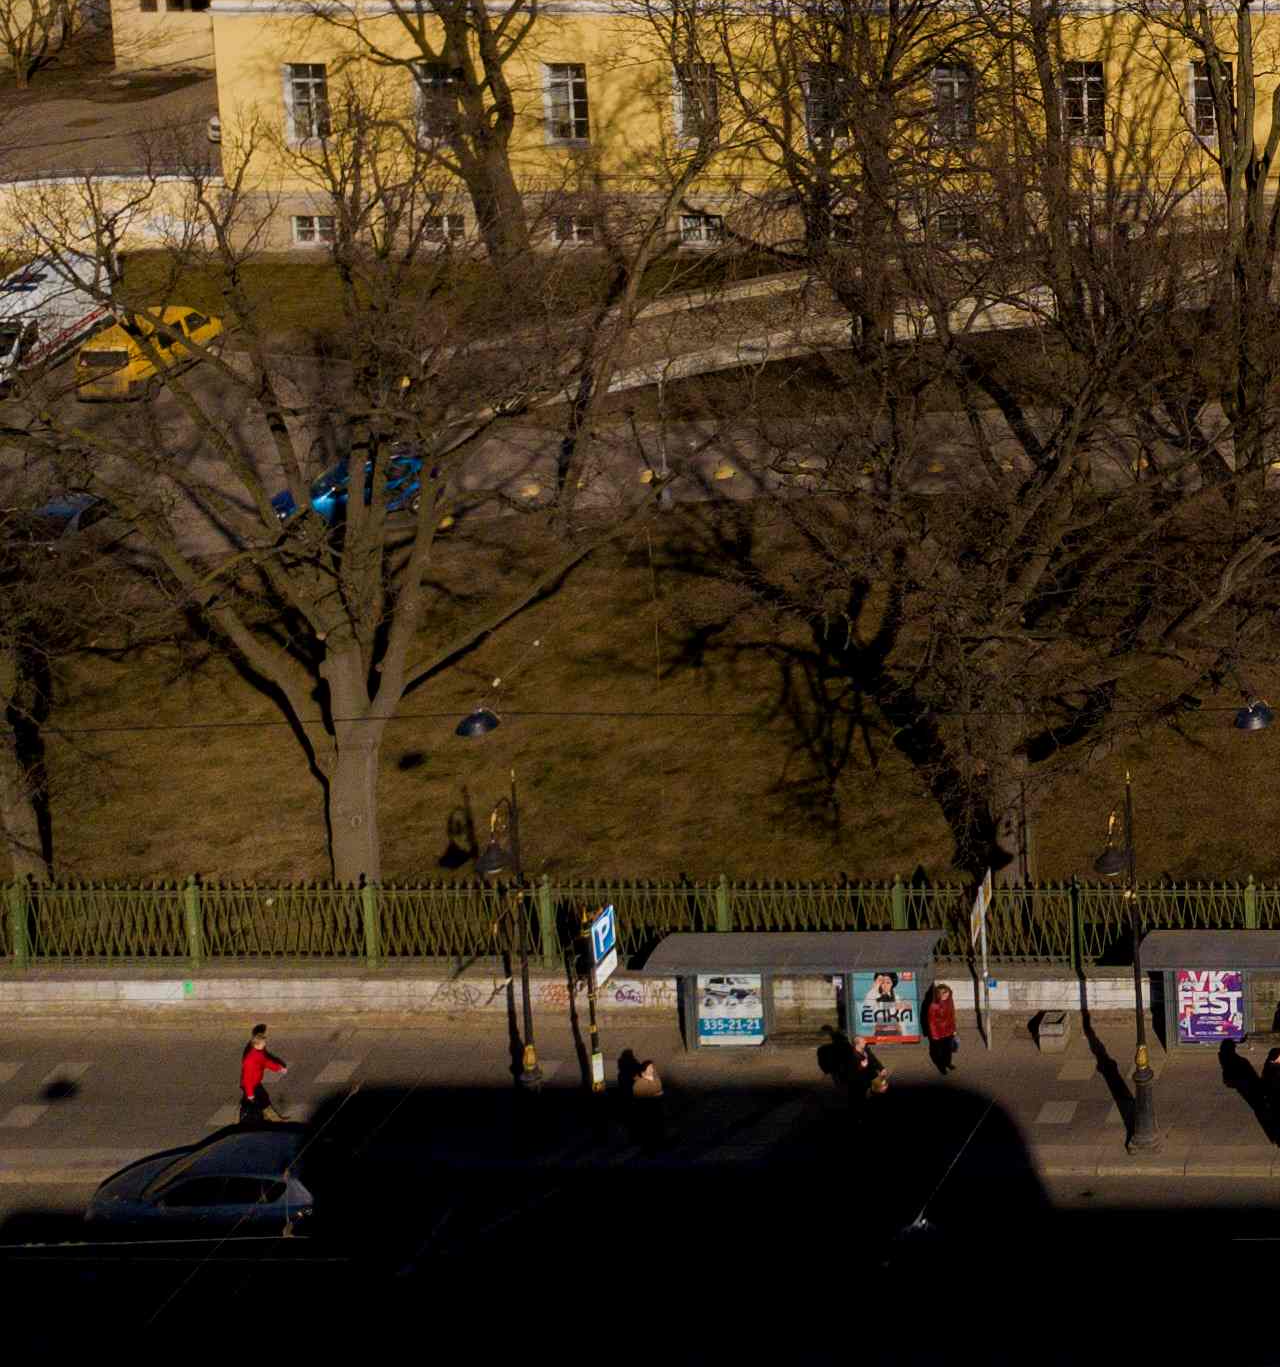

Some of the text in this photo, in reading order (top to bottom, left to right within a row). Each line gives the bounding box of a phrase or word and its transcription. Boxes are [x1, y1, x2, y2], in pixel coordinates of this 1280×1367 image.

[1188, 970, 1226, 991] VK
[1178, 991, 1242, 1015] FEST
[703, 1019, 761, 1030] 335-21-21
